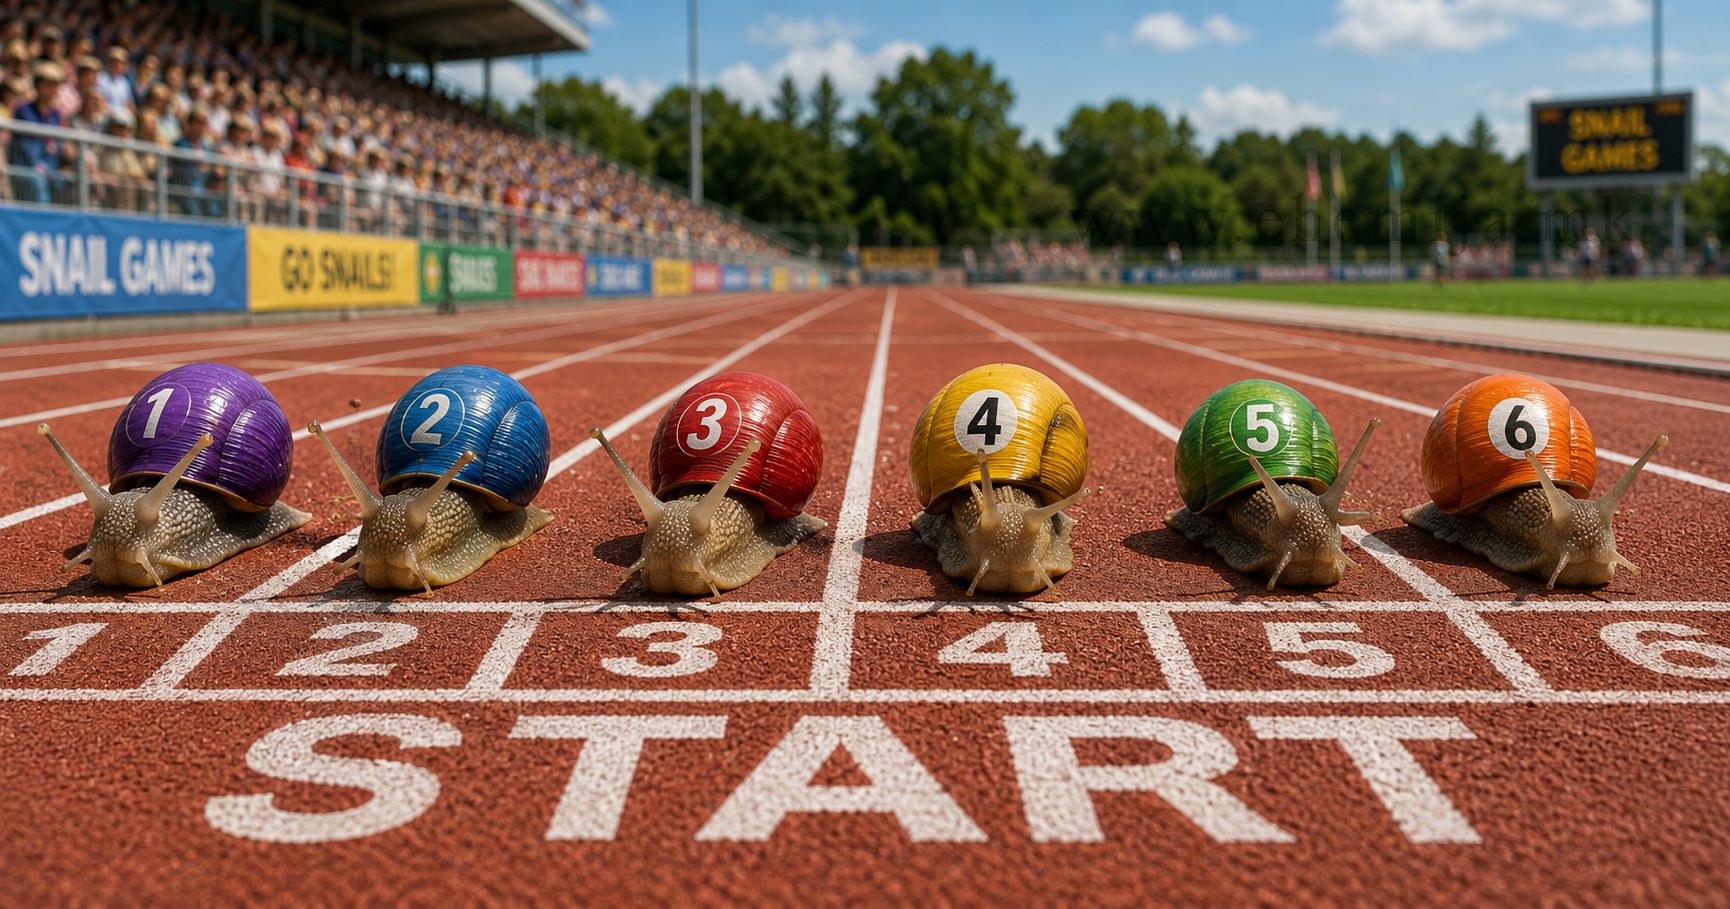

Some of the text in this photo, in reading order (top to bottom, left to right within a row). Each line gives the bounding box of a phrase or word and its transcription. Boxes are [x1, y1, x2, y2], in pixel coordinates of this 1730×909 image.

[1568, 106, 1652, 141] SNAIL
[1560, 138, 1660, 174] GAMES
[18, 230, 215, 297] SNAIL GAMES
[280, 245, 315, 294] GO
[142, 388, 175, 439] 1
[410, 394, 450, 446] 2
[686, 398, 727, 451] 3
[966, 396, 1002, 446] 4
[1245, 403, 1280, 452] 5
[1503, 404, 1537, 451] 6
[9, 620, 1730, 680] 1 2 3 4 5 6
[204, 713, 1483, 845] START
